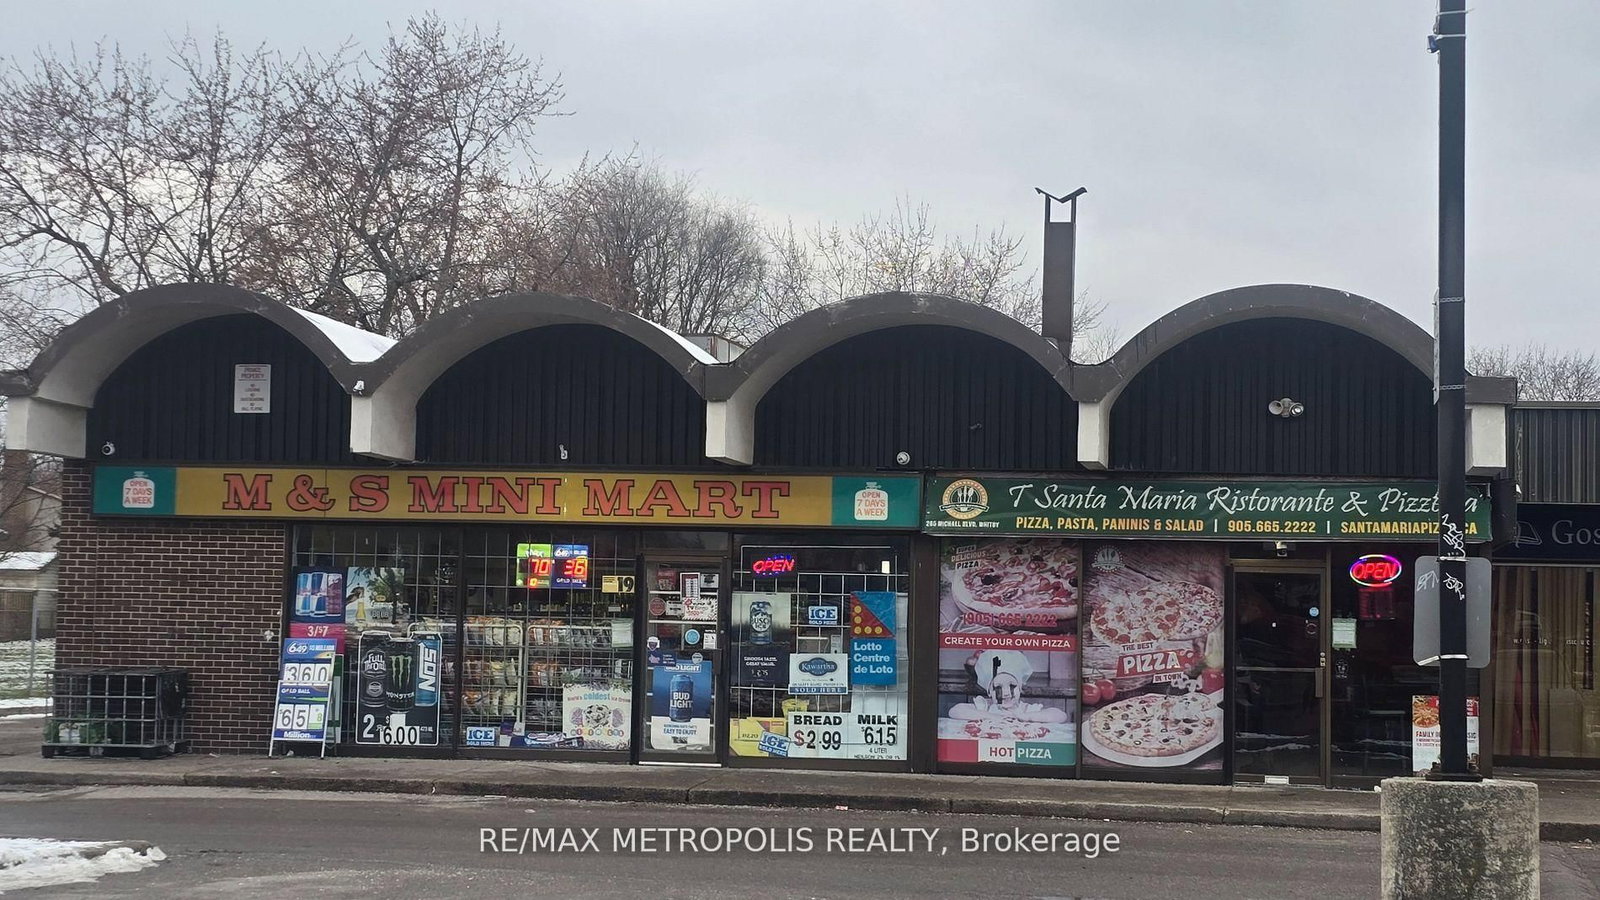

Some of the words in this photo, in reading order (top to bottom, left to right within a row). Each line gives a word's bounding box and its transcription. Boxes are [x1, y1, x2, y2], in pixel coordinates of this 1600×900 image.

[125, 487, 132, 496] 7
[133, 487, 153, 496] DAYS
[222, 473, 272, 511] M
[286, 474, 336, 512] &
[349, 475, 389, 512] S
[407, 476, 561, 515] MINI
[582, 478, 790, 519] MART
[861, 491, 881, 499] OPEN
[132, 496, 153, 505] WEEK
[857, 499, 865, 507] 7
[865, 499, 886, 508] DAYS
[1009, 484, 1033, 508] T
[1035, 484, 1107, 510] Santa
[1117, 485, 1197, 510] Maria
[1206, 486, 1335, 515] Ristorante
[1341, 491, 1369, 517] &
[856, 507, 863, 516] A
[864, 507, 886, 516] WEEK
[1016, 517, 1053, 531] PIZZA,
[1057, 517, 1098, 532] PASTA,
[1102, 518, 1150, 531] PANINIS
[1154, 519, 1161, 531] &
[1165, 519, 1204, 532] SALAD
[1228, 519, 1316, 533] 905.665.2222
[752, 558, 796, 573] OPEN
[956, 561, 979, 569] PIZZA
[1352, 561, 1398, 580] OPEN
[618, 576, 634, 592] 19
[810, 609, 836, 619] ICE
[853, 642, 882, 651] Lotto
[944, 636, 982, 645] CREATE
[985, 637, 1013, 646] YOUR
[1015, 638, 1039, 647] OWN
[1042, 639, 1071, 648] PIZZA
[1122, 643, 1135, 651] THE
[1137, 642, 1154, 650] BEST
[853, 653, 890, 662] Centre
[1122, 651, 1181, 675] PIZZA
[418, 642, 437, 692] NOS
[801, 662, 835, 671] Kawartha
[853, 664, 867, 674] de
[869, 664, 893, 674] Loto
[1164, 673, 1182, 681] TOWN
[583, 692, 610, 700] coldest
[673, 692, 690, 700] BUD
[670, 700, 694, 709] LIGHT
[362, 713, 375, 738] 2
[793, 715, 843, 726] BREAD
[857, 714, 898, 726] MILK
[383, 726, 418, 745] 6.00
[468, 729, 493, 740] ICE
[793, 730, 842, 750] $2.99
[761, 733, 788, 750] ICE
[989, 746, 1014, 757] HOT
[1017, 747, 1052, 759] PIZZA
